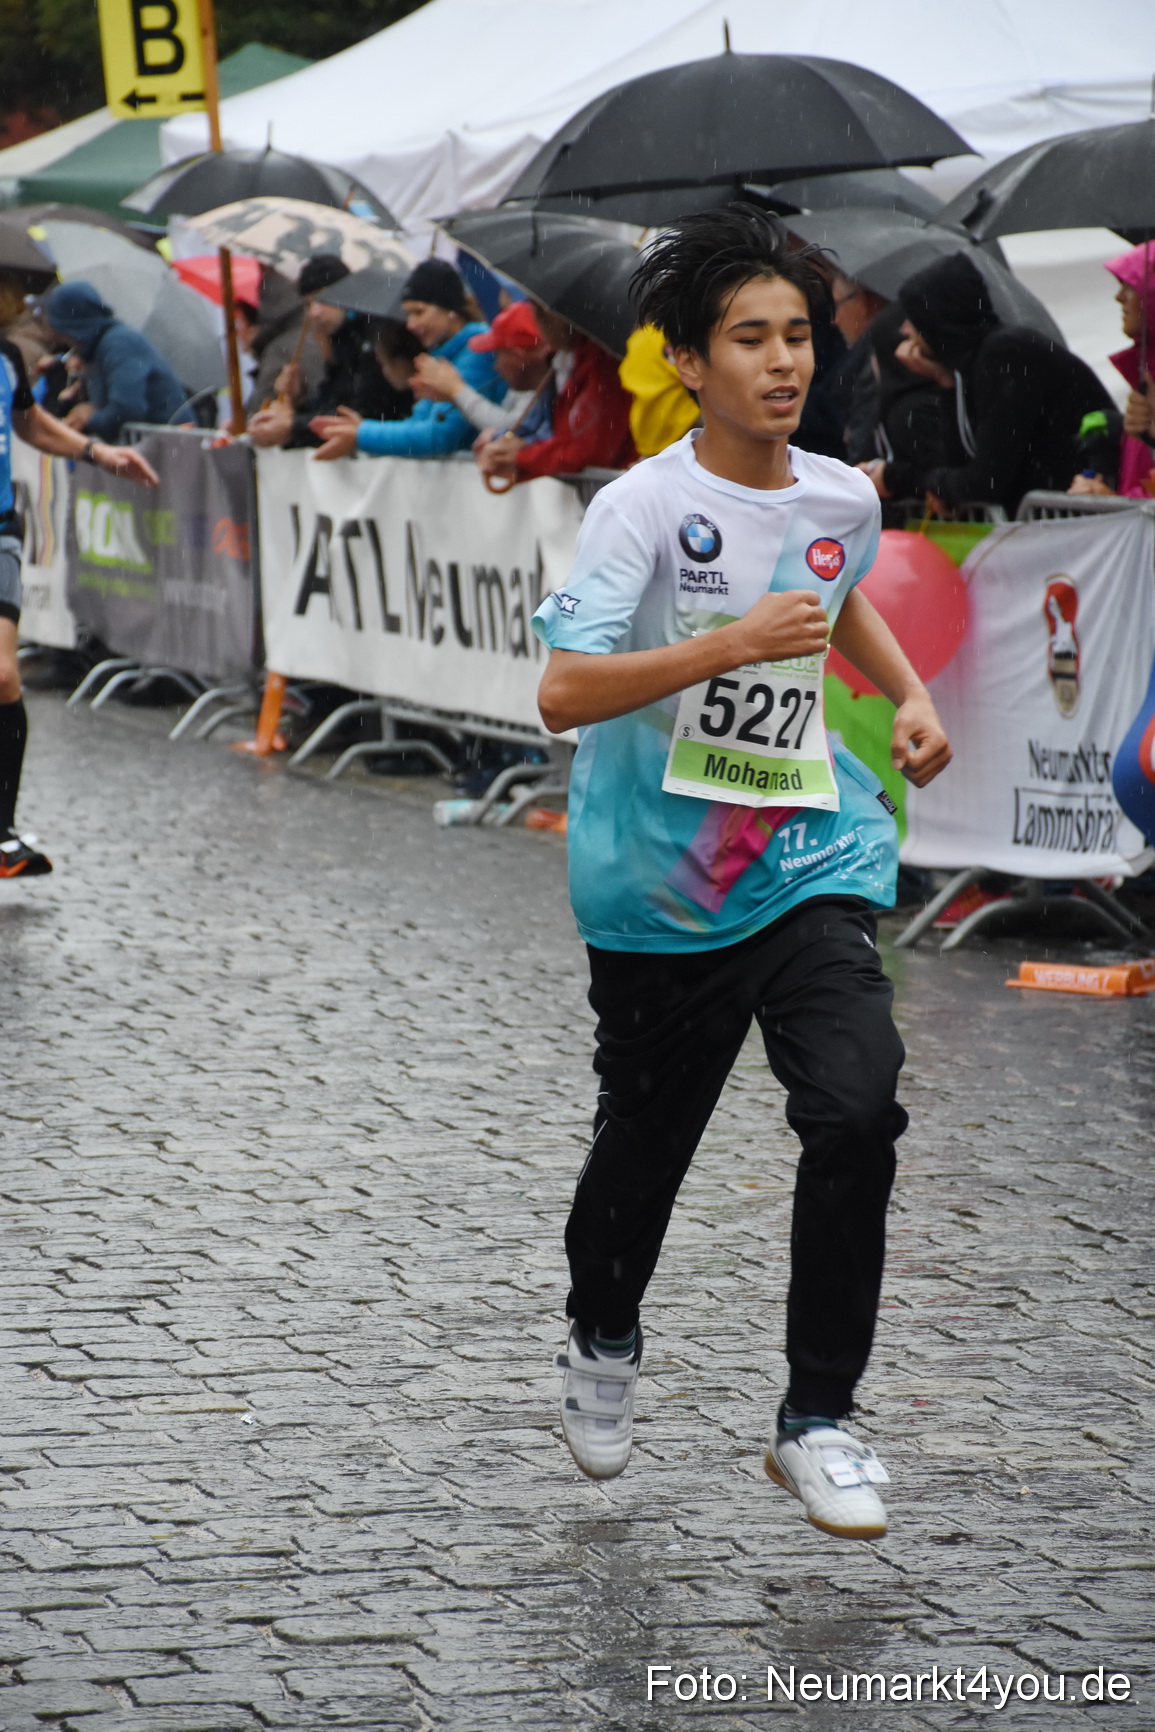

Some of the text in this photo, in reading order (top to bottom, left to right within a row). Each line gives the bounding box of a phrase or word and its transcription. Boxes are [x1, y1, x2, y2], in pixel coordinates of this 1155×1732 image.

[131, 0, 185, 76] B
[679, 568, 729, 585] PARTL
[679, 582, 729, 596] Neumarkt
[682, 726, 692, 738] S
[700, 677, 816, 750] 5227
[1012, 786, 1120, 854] Lammsbrä
